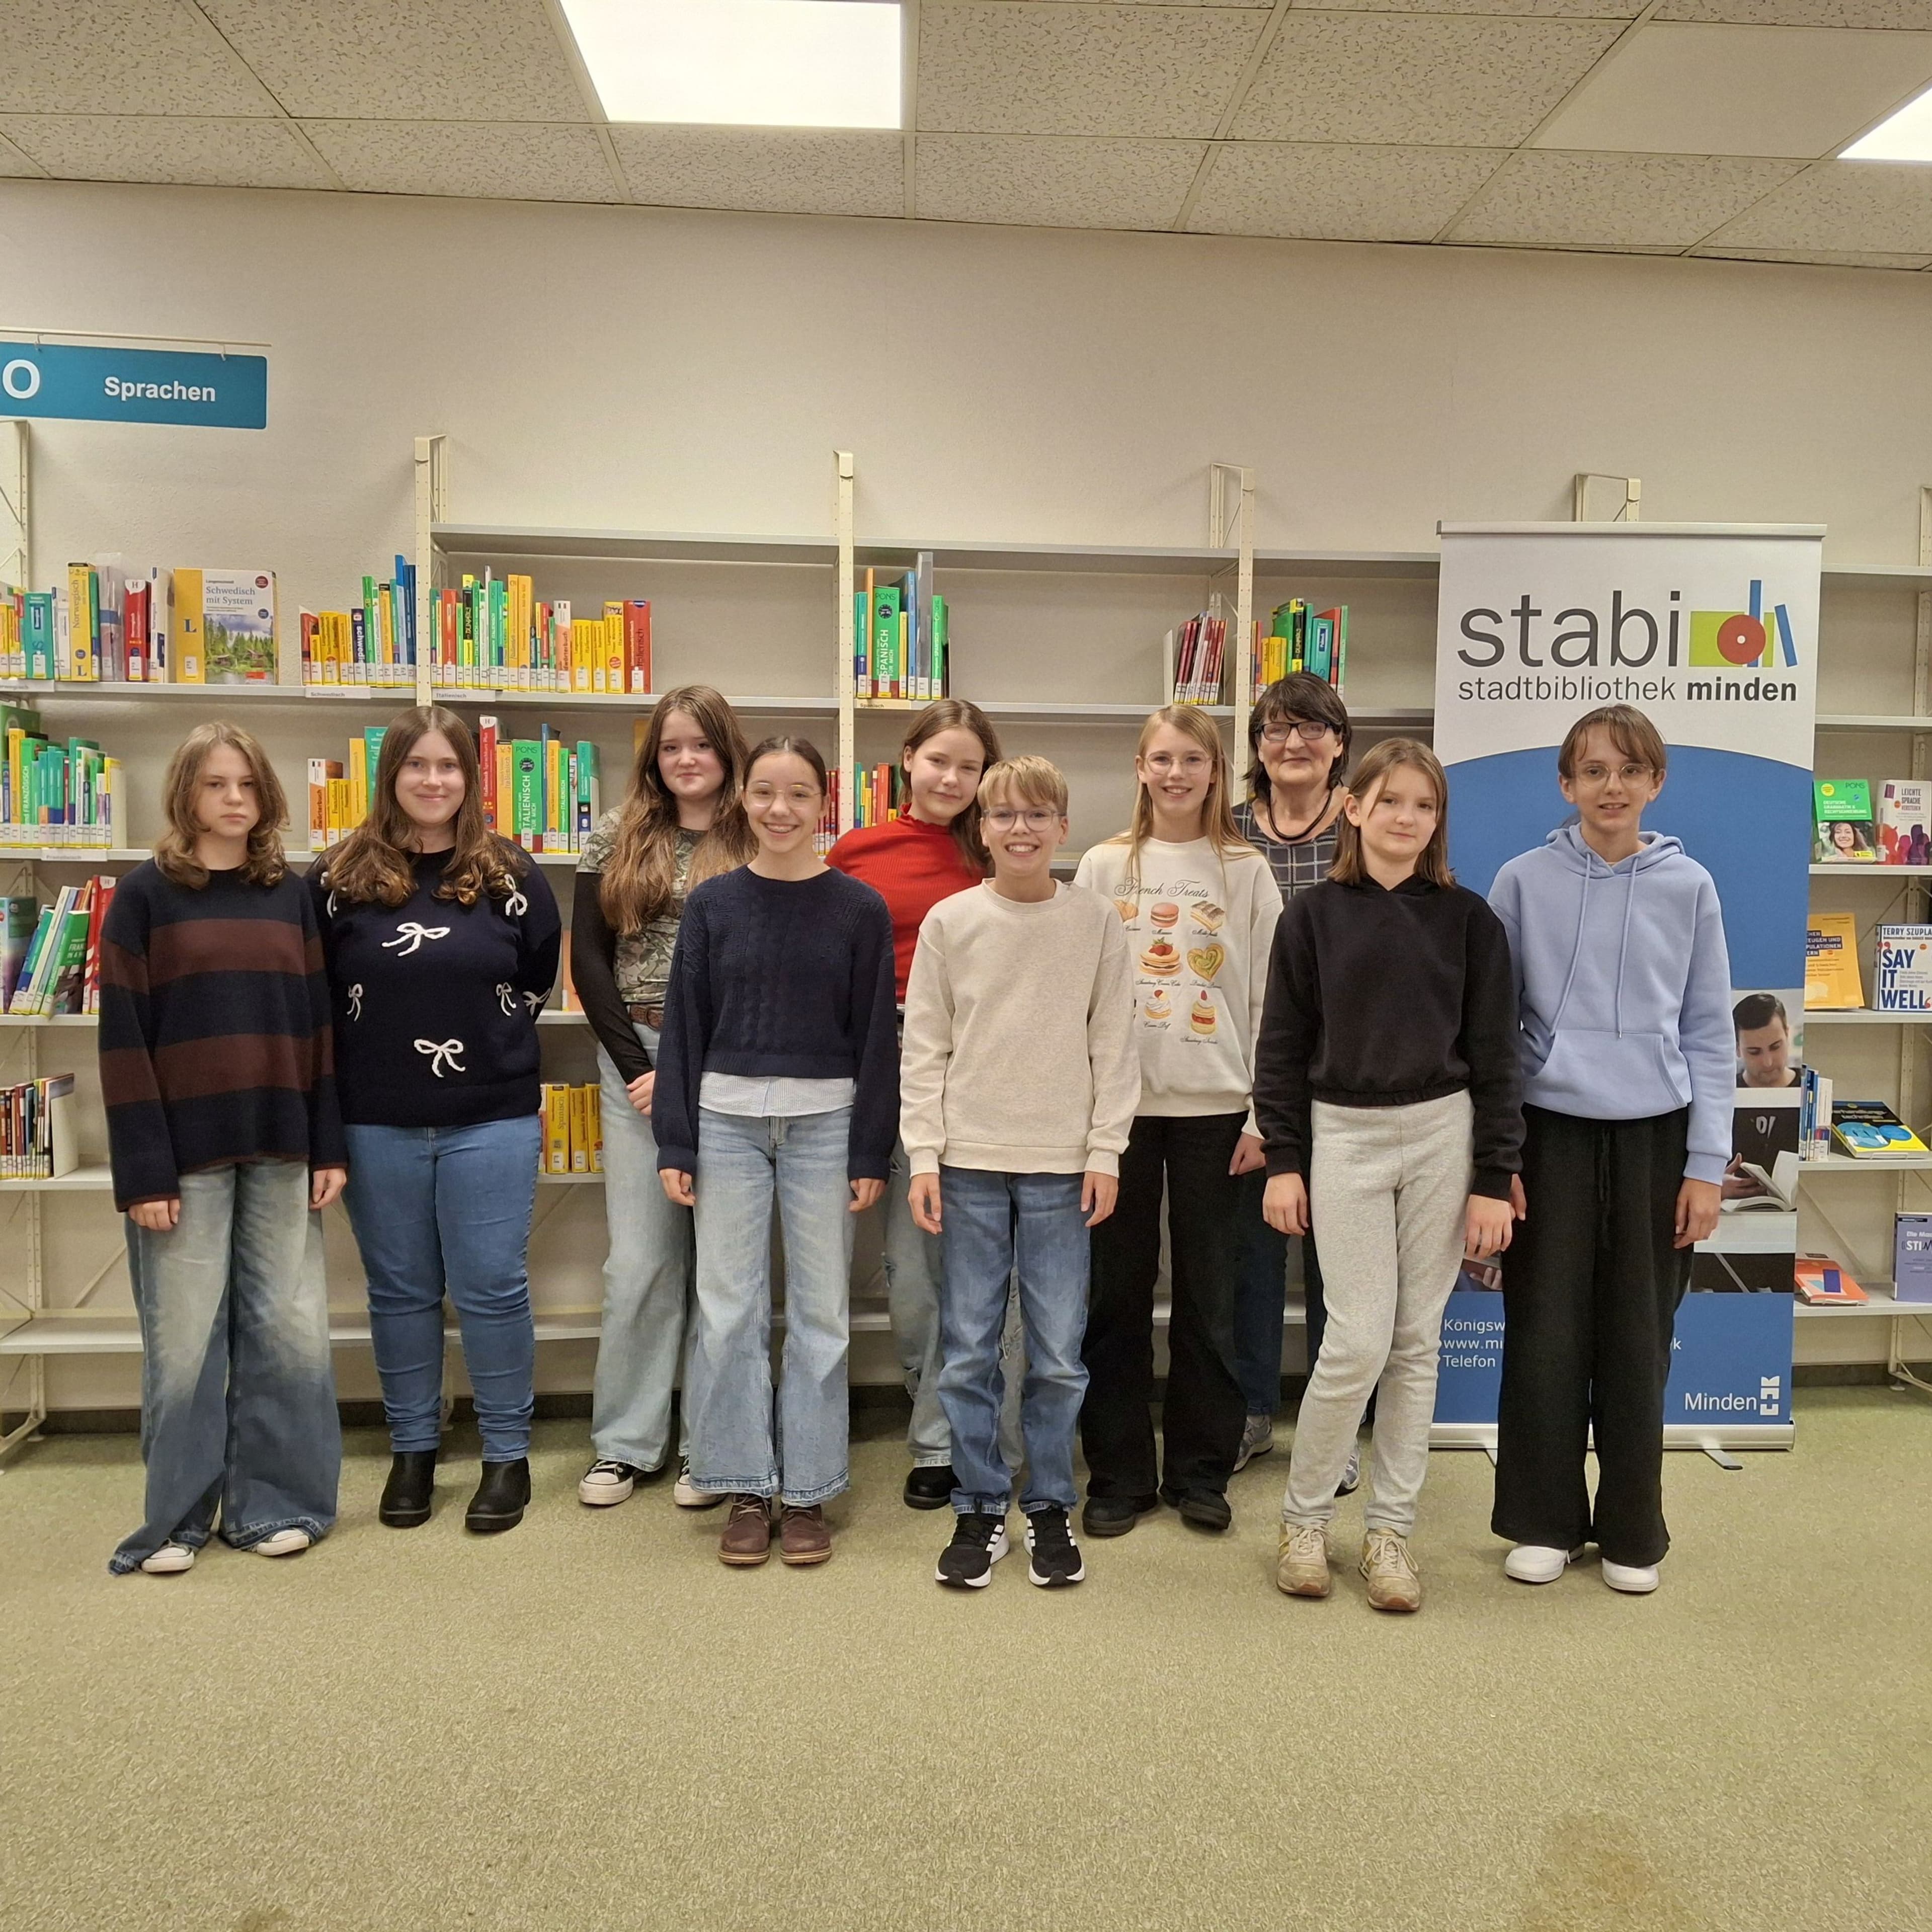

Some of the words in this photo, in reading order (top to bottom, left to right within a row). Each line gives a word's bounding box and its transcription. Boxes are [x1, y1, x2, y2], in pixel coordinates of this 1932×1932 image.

[2, 359, 41, 399] O
[104, 376, 216, 402] Sprachen
[205, 586, 256, 596] Schwedisch
[71, 580, 80, 628] Norwegisch
[206, 597, 220, 605] mit
[222, 597, 254, 606] System
[183, 619, 197, 633] L
[1457, 590, 1680, 668] stabi
[635, 628, 645, 667] Italienisch
[880, 629, 889, 675] SPANISCH
[1458, 676, 1676, 701] stadtbibliothek
[1686, 677, 1797, 702] minden
[22, 765, 30, 813] FRANZÖSISCH
[1901, 788, 1921, 796] LEICHTE
[1114, 876, 1164, 897] Fench
[1167, 879, 1209, 898] Treats
[1883, 927, 1905, 935] TERRY
[1906, 927, 1932, 936] SZUPLA
[1882, 949, 1915, 969] SAY
[1882, 969, 1898, 988] IT
[1881, 989, 1925, 1009] WELL
[1442, 1354, 1496, 1367] Telefon
[1685, 1392, 1757, 1411] Minden
